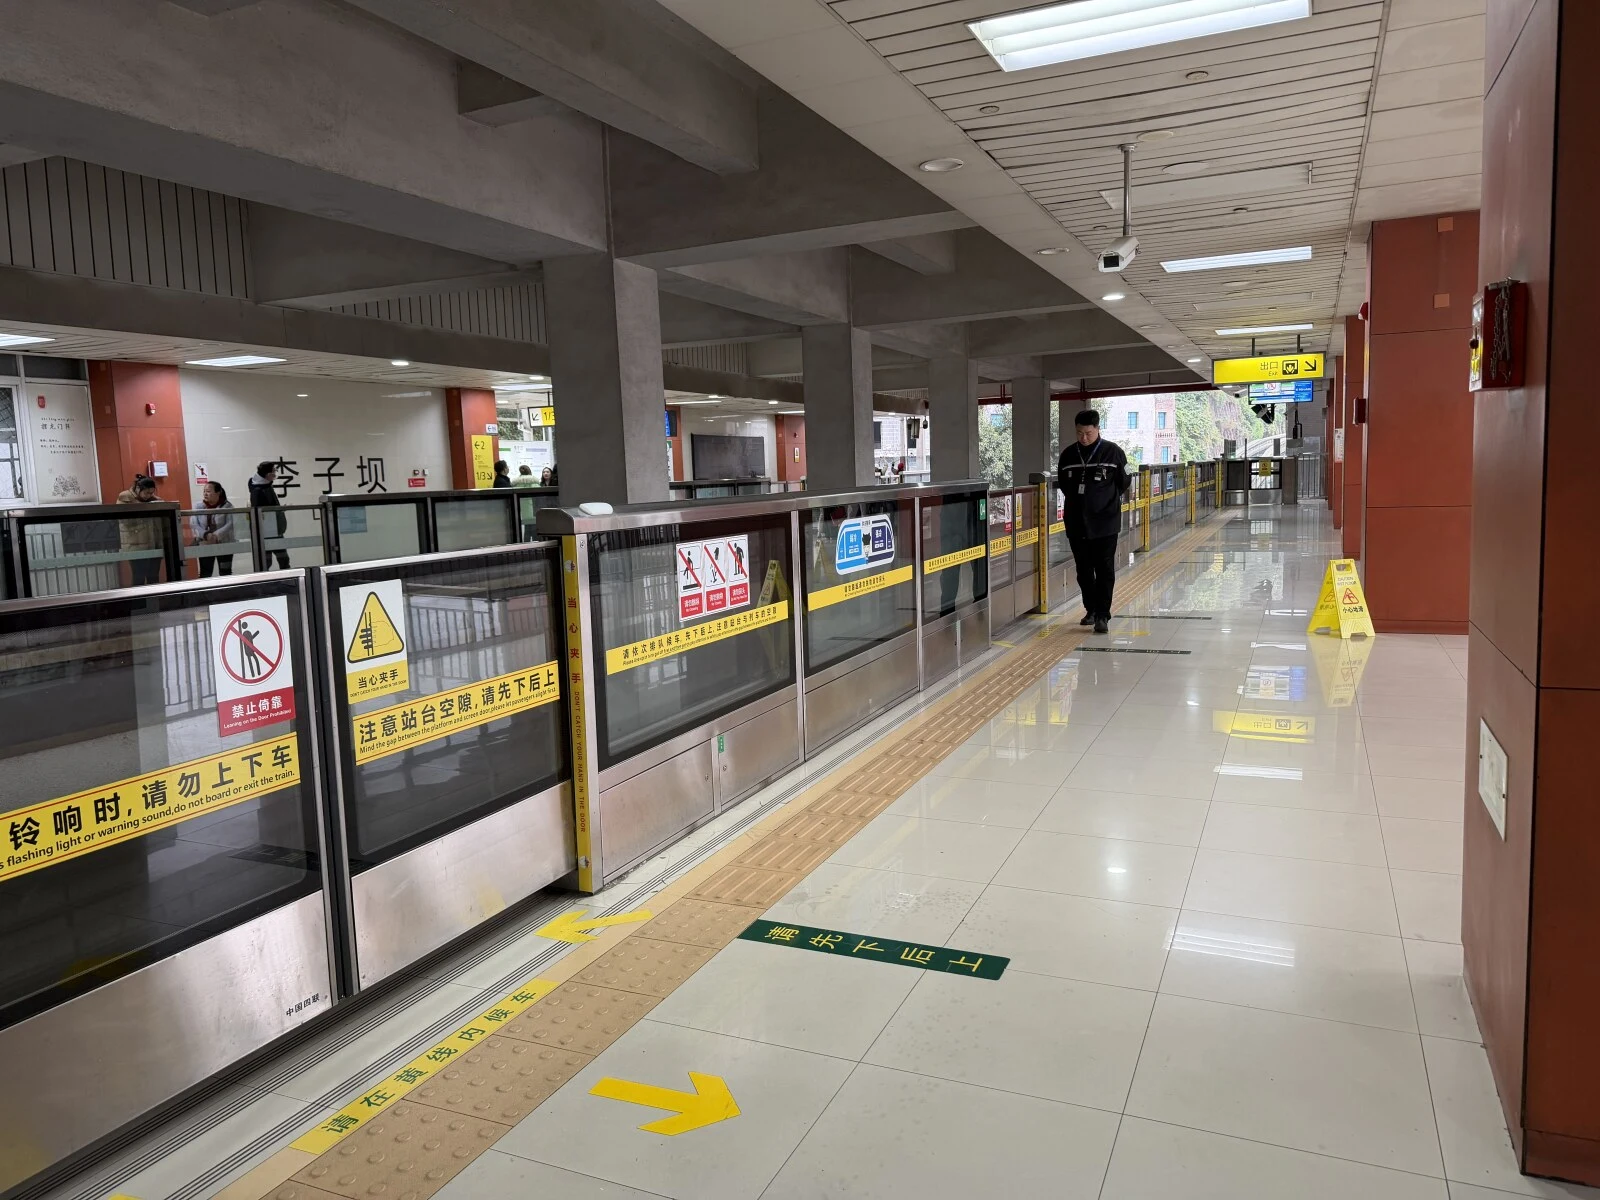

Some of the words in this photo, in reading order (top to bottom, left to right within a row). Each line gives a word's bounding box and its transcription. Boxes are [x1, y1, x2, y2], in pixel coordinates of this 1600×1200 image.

[1260, 361, 1279, 371] 出口
[272, 455, 387, 494] 李子坝
[476, 471, 486, 480] 1/3
[568, 596, 582, 684] 当心夹手
[358, 669, 398, 689] 当心夹手
[231, 695, 283, 719] 禁止倚靠
[223, 720, 243, 729] Leaning
[360, 743, 375, 754] Mind
[375, 740, 386, 748] the
[386, 738, 397, 748] gap
[397, 730, 421, 742] between
[421, 726, 431, 734] the
[430, 718, 454, 732] platform
[453, 715, 463, 724] and
[463, 711, 479, 721] screen
[578, 785, 585, 793] IN
[6, 845, 54, 867] flashing
[56, 835, 82, 852] light
[84, 832, 96, 842] or
[97, 818, 140, 838] warning
[188, 797, 204, 809] not
[206, 787, 231, 805] board
[233, 785, 243, 794] or
[243, 778, 259, 791] exit
[260, 775, 274, 786] the
[275, 769, 295, 781] train.
[765, 926, 983, 972] 请先下后上
[321, 989, 537, 1134] 请在黄线内候车
